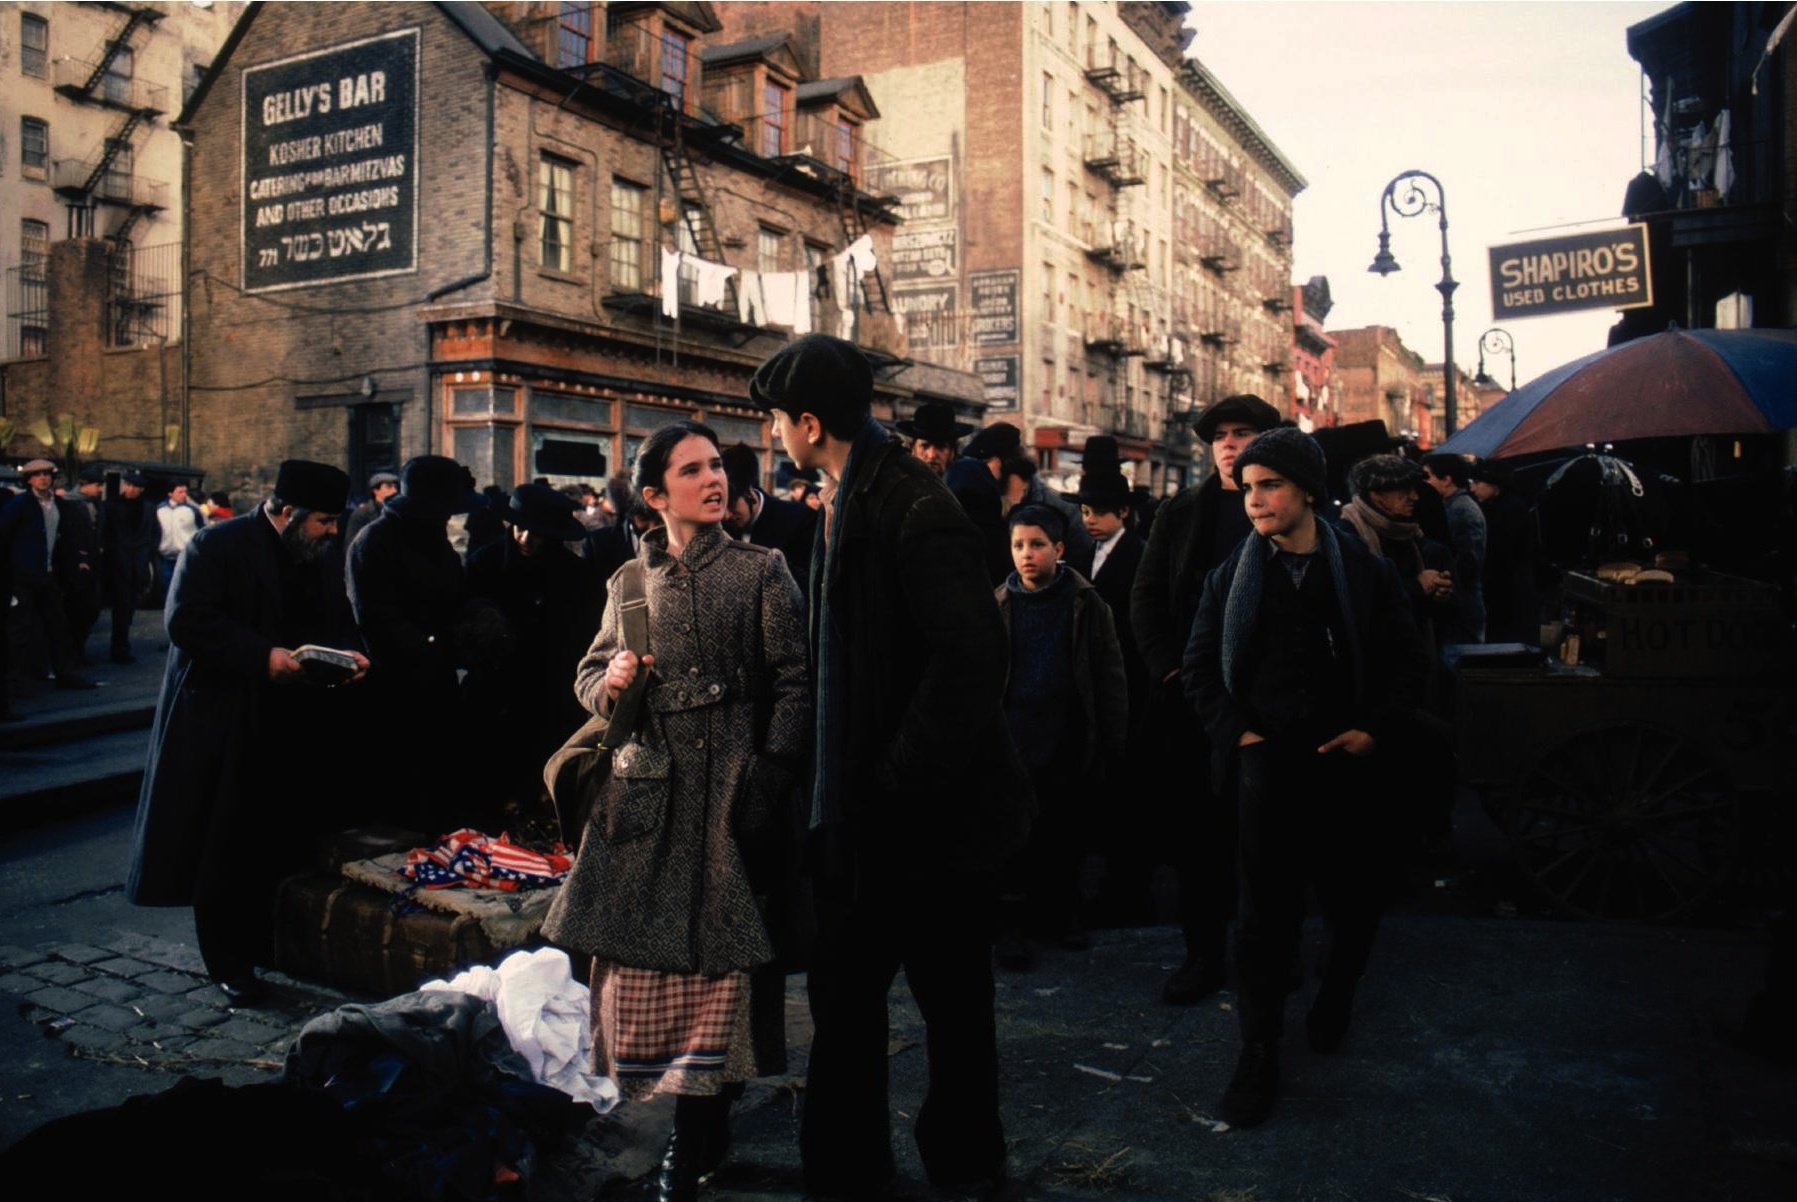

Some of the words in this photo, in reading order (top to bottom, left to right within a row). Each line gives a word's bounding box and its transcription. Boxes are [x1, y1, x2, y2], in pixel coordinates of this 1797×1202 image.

[262, 82, 332, 126] GELLY'S
[339, 71, 386, 110] BAR
[269, 136, 321, 166] KOSHER
[325, 123, 384, 155] KITCHEN
[250, 173, 305, 200] CATERING
[256, 205, 284, 227] AND
[287, 198, 325, 222] OTHER
[328, 186, 399, 215] OCCASIONS
[1500, 243, 1638, 288] SHAPIRO'S
[1503, 288, 1545, 307] USED
[1552, 277, 1640, 301] CLOTHES
[1621, 618, 1695, 651] HOT
